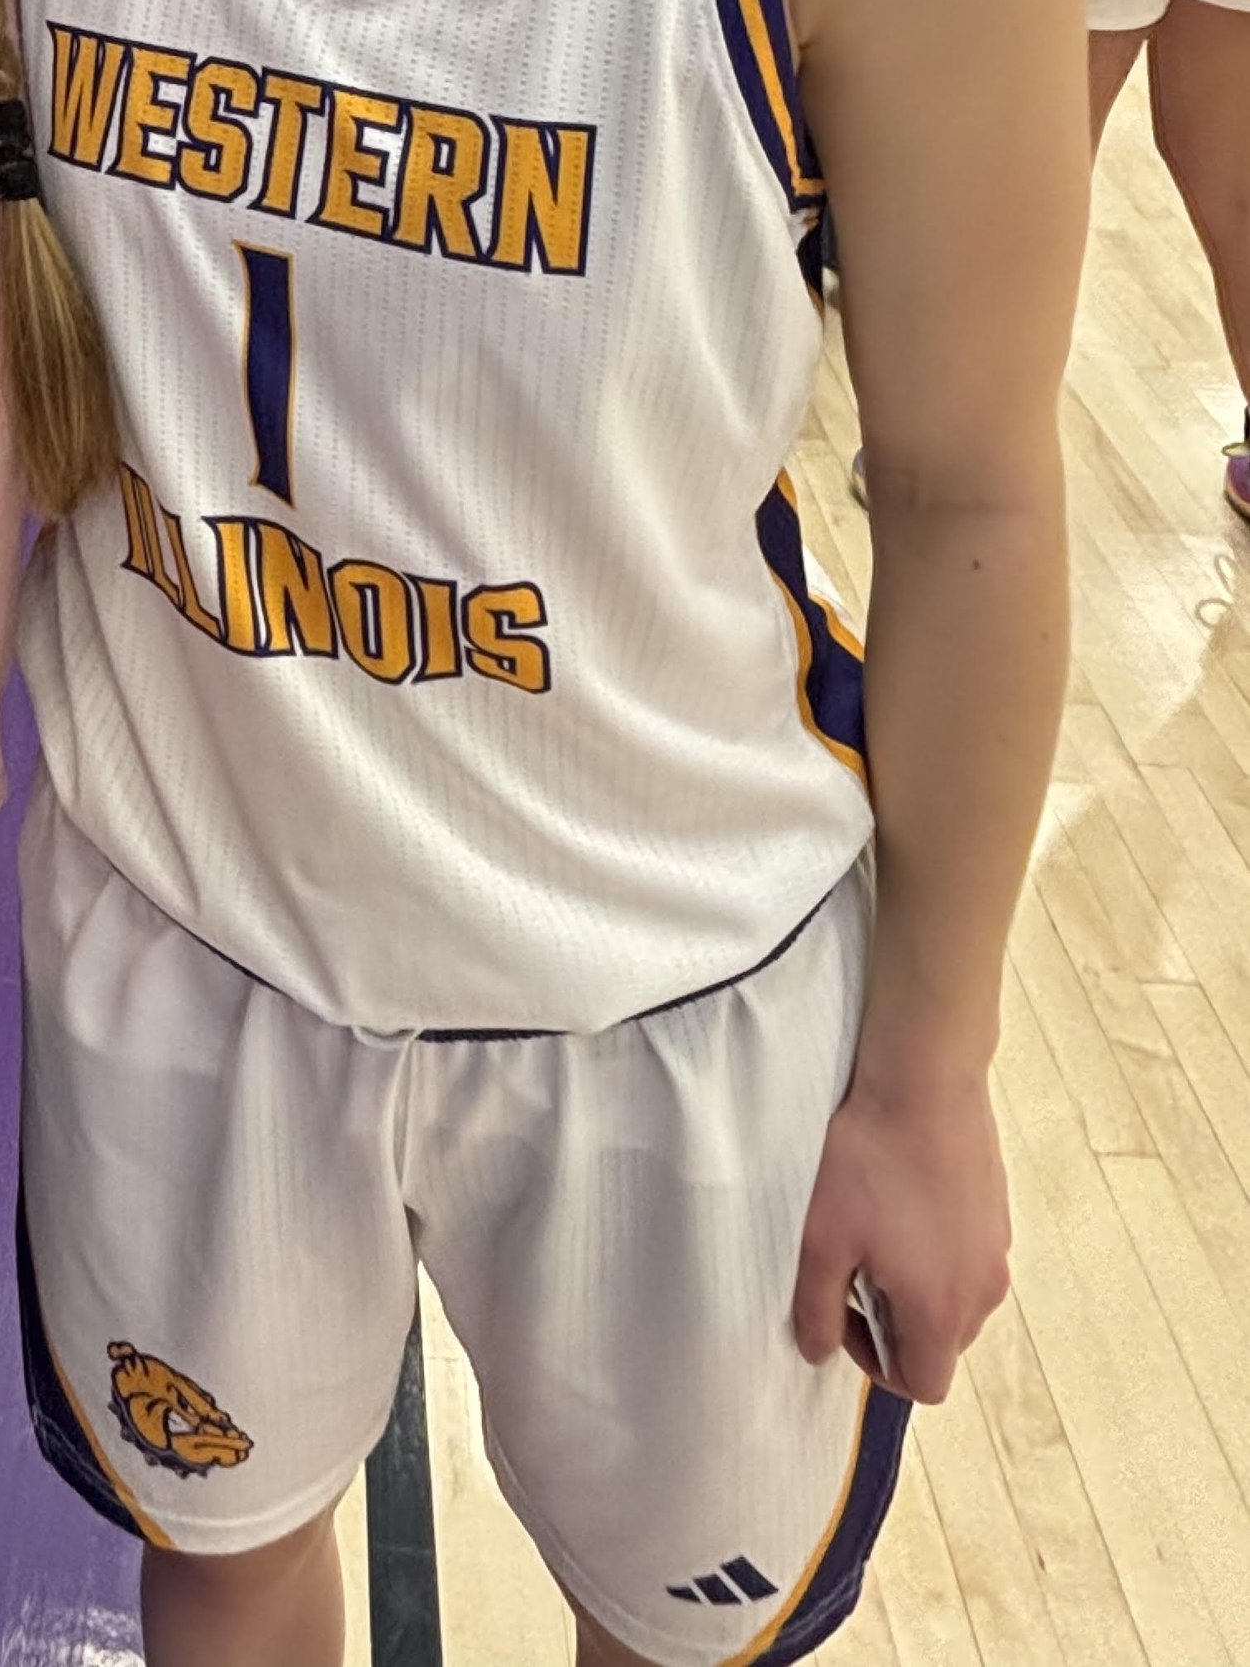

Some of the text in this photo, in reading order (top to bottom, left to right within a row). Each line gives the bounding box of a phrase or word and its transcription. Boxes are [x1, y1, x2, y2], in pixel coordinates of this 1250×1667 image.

[46, 21, 597, 277] WESTERN
[232, 239, 297, 510] 1
[120, 460, 551, 695] ILLINOIS
